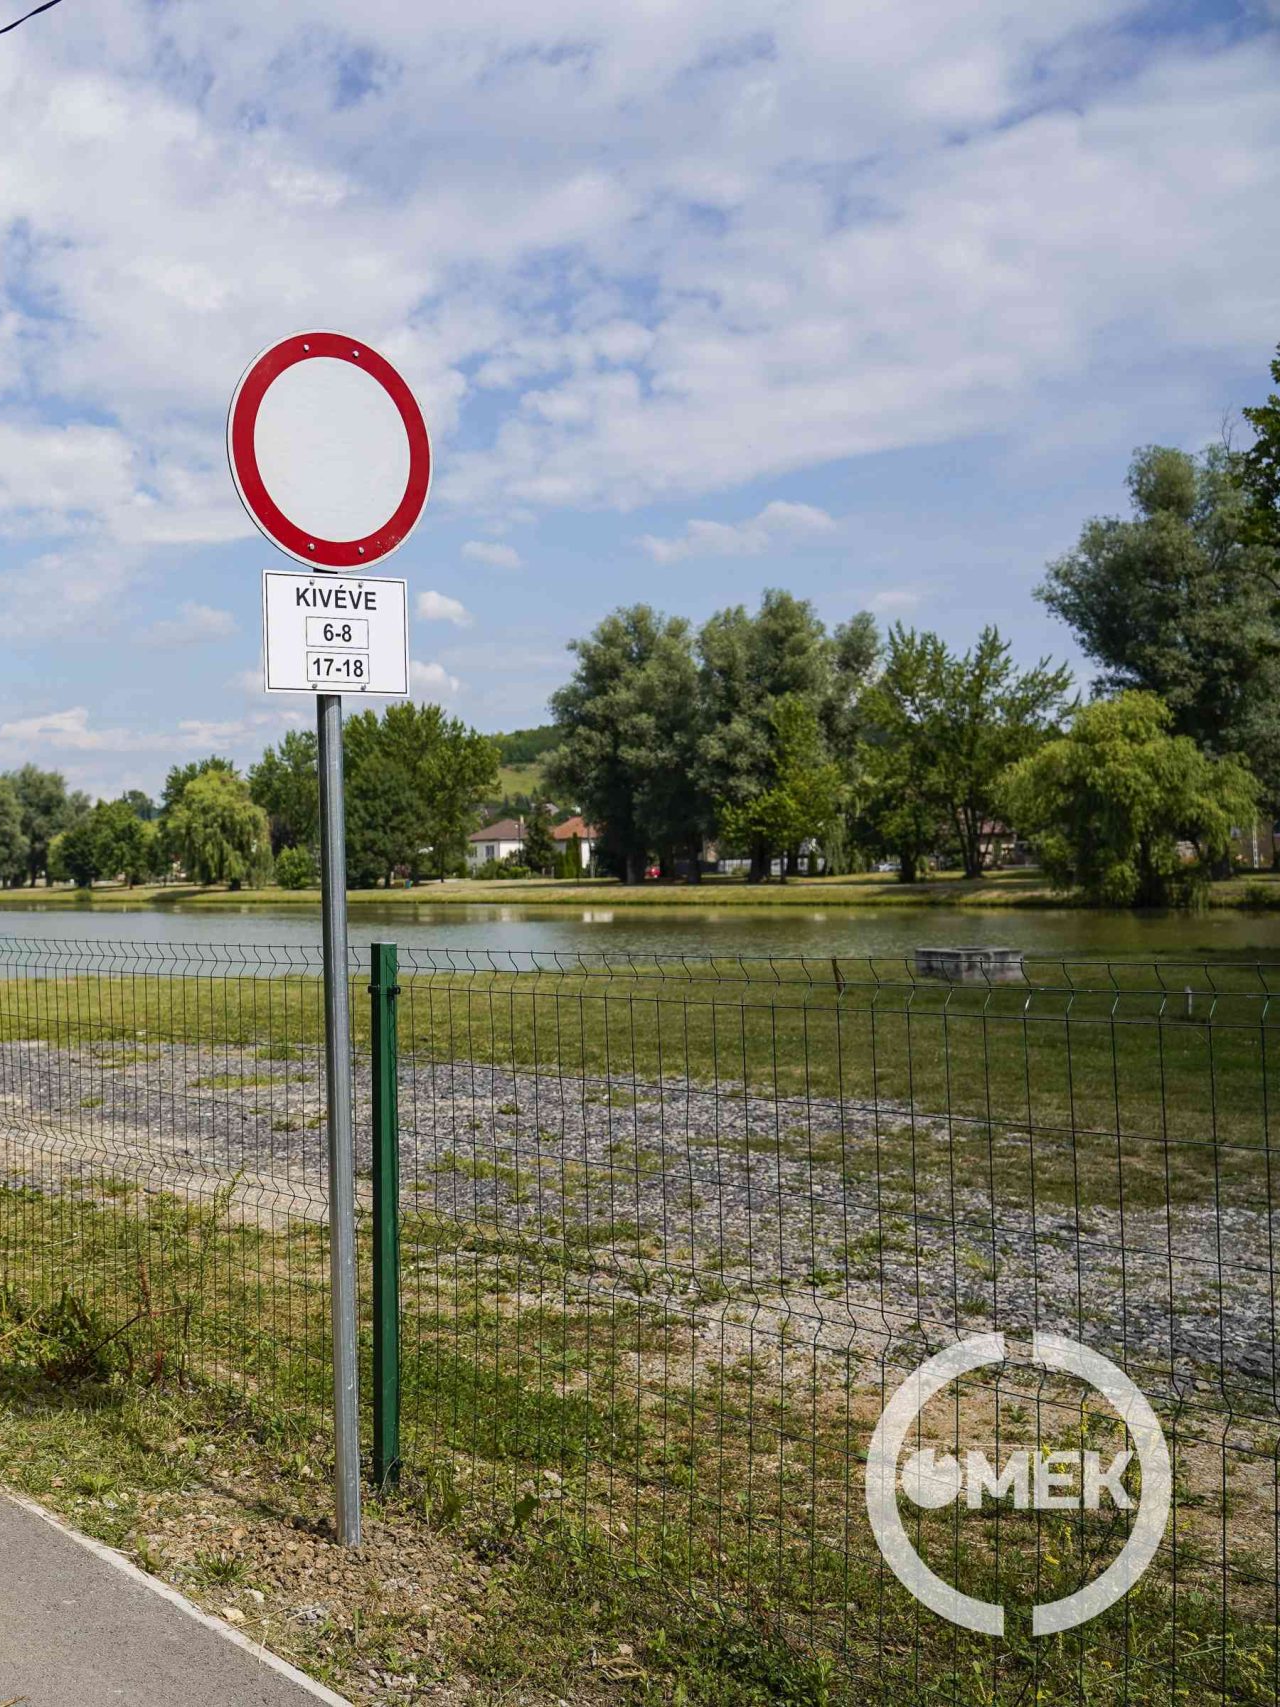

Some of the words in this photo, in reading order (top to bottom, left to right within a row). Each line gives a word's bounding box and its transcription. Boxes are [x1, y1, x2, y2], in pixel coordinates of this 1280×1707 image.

[296, 585, 377, 610] KIVÉVE
[323, 623, 352, 642] 6-8
[312, 657, 364, 677] 17-18
